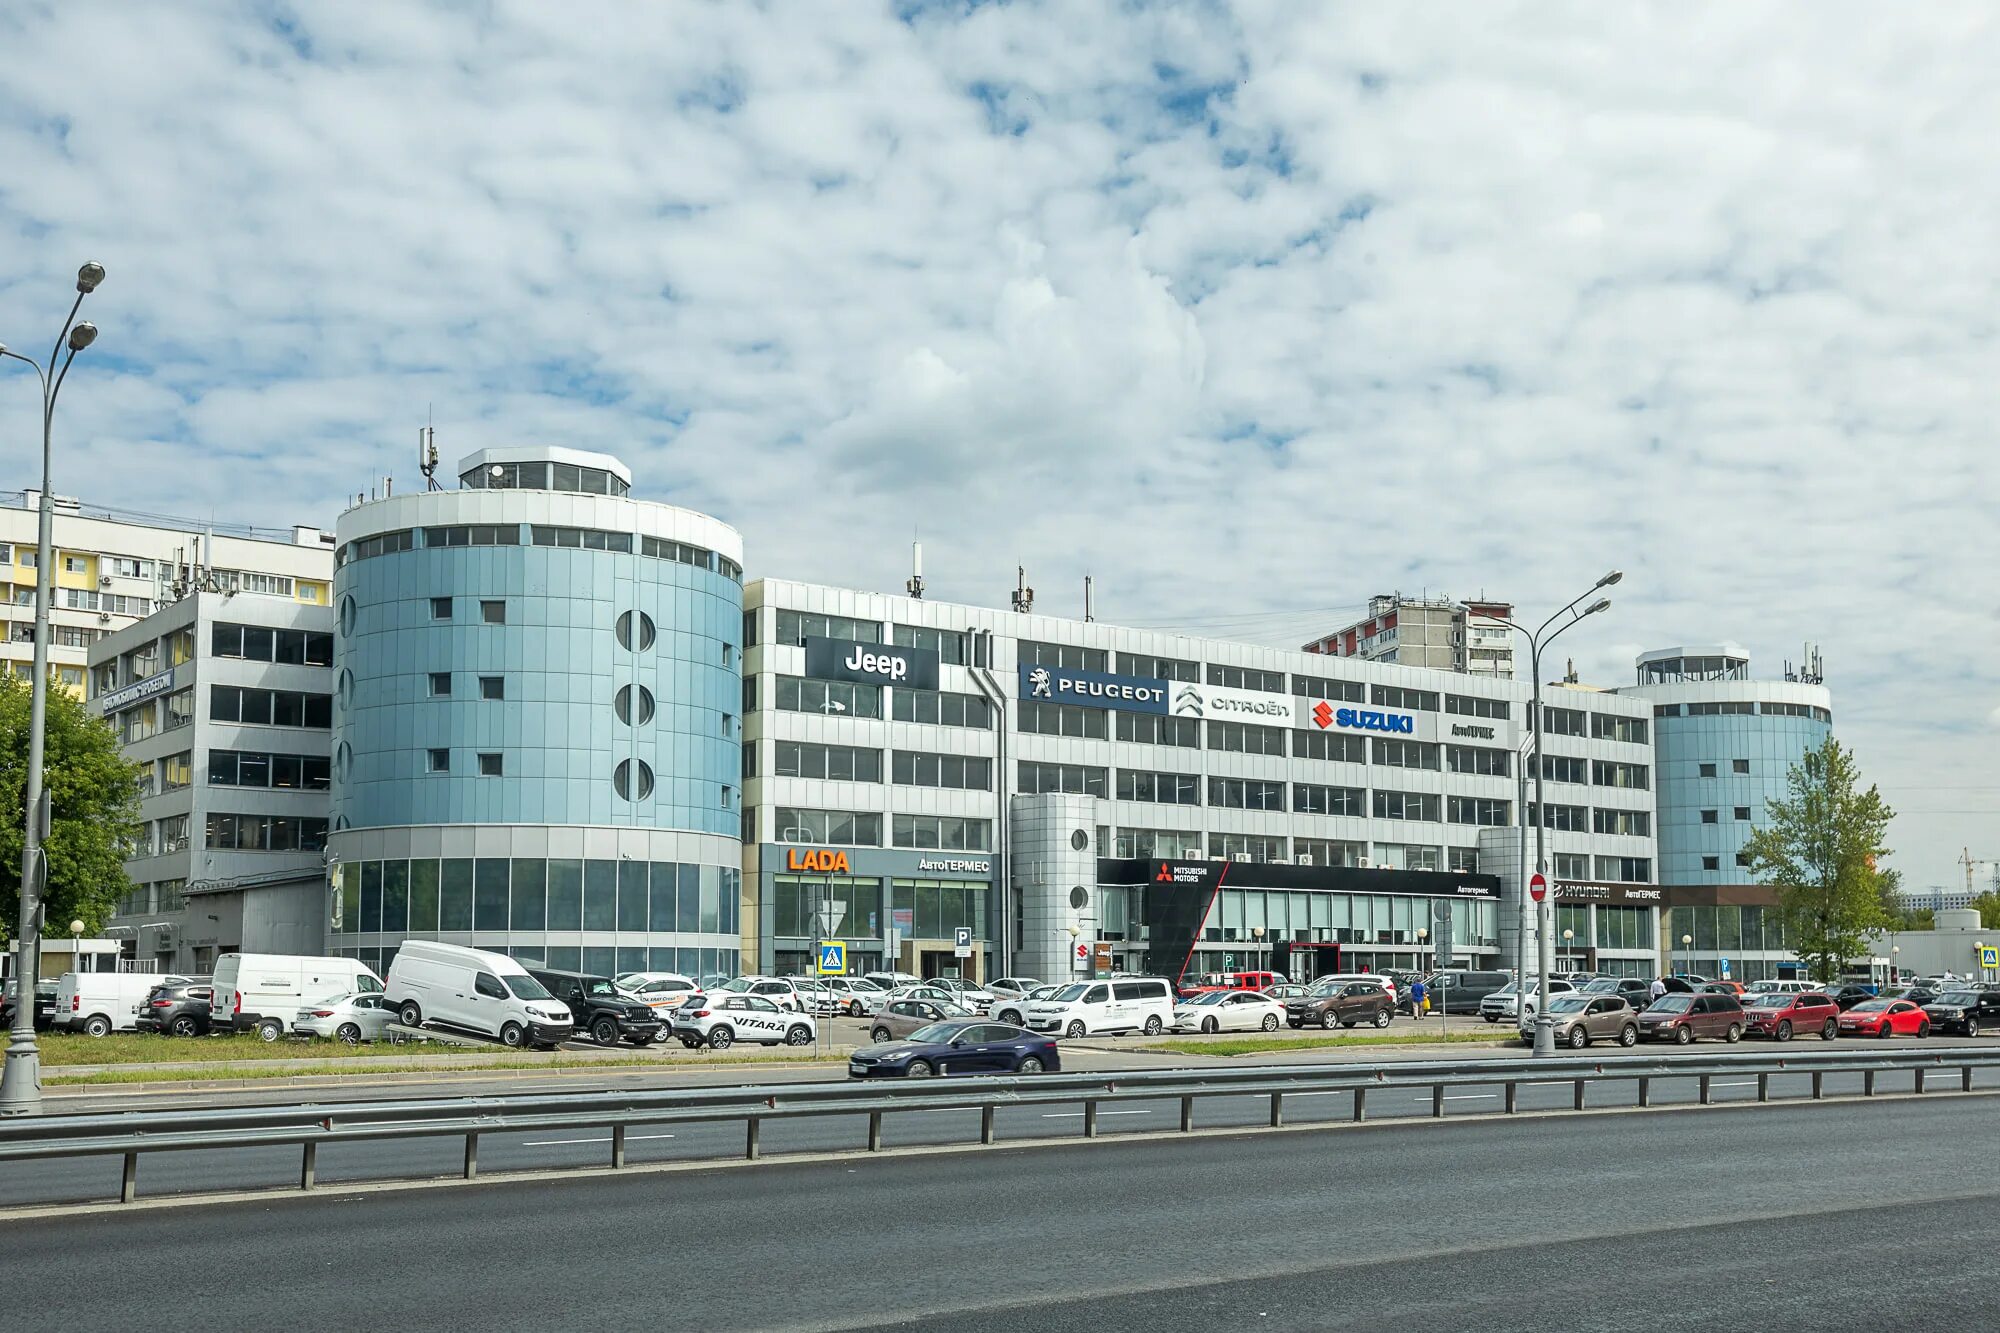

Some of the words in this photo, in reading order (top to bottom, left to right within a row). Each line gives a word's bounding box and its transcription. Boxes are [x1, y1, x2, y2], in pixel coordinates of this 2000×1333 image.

[845, 646, 906, 680] Jeep
[1059, 678, 1163, 702] PEUGEOT
[1336, 708, 1413, 733] SUZUKI
[788, 848, 849, 872] LADA
[919, 859, 989, 872] АвтоГЕРМЕС
[1173, 866, 1207, 875] MITSUBISHI
[1173, 875, 1199, 883] MOTORS
[1457, 885, 1489, 895] Автогермес
[1565, 885, 1610, 898] HYUNDAI
[1625, 889, 1661, 900] АвтоГЕРМЕС
[958, 931, 968, 945] P
[733, 1016, 785, 1032] VITARA
